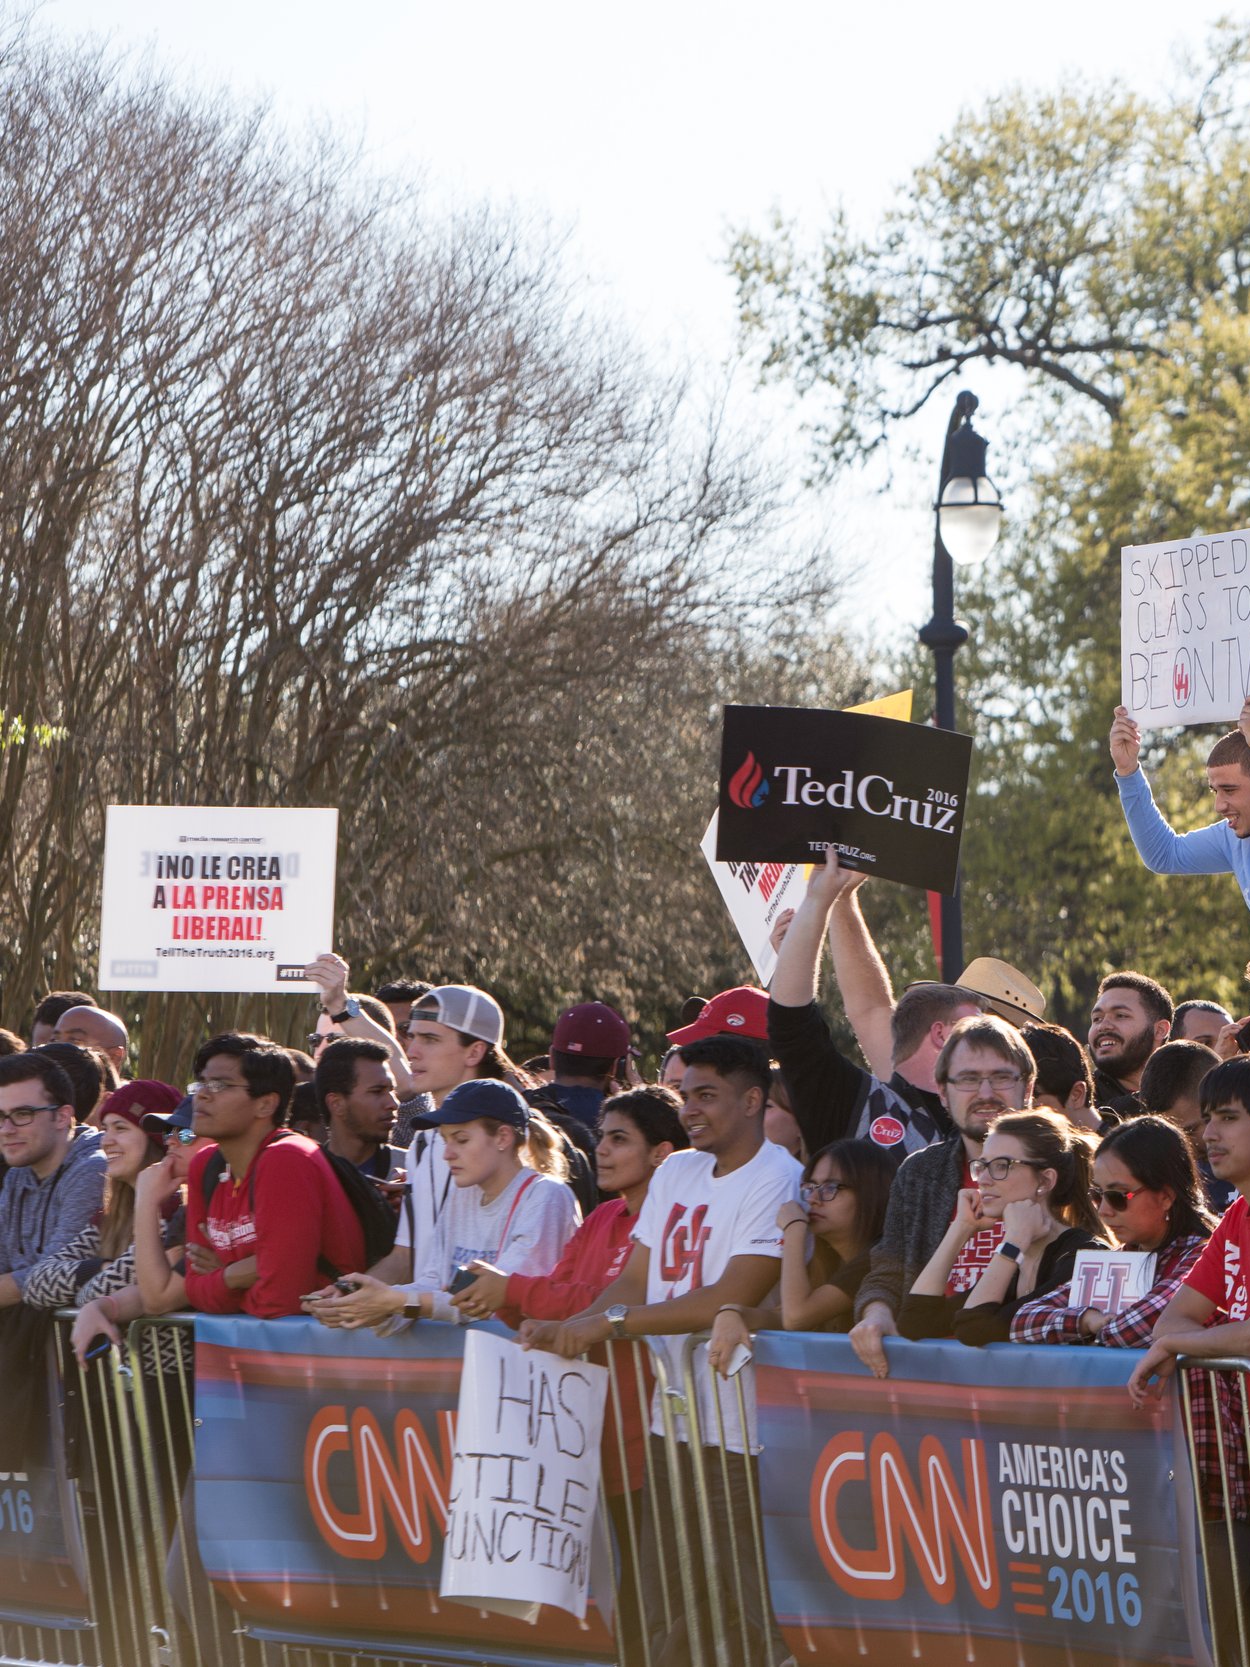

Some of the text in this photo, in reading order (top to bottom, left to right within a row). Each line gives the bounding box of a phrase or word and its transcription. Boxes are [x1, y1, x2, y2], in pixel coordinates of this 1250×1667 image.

[1129, 538, 1248, 596] SKIPPED
[1137, 592, 1207, 643] CLASS
[1129, 651, 1169, 711] BE
[1172, 640, 1215, 708] ON
[926, 787, 959, 808] 2016
[201, 855, 221, 880] LE
[227, 856, 281, 880] CREA
[152, 885, 284, 911] A LA PRENSA
[171, 915, 264, 941] LIBERAL!
[155, 947, 275, 961] TellTheTruth2016.org
[280, 968, 309, 978] #TTT
[872, 1124, 901, 1138] Cruz
[496, 1356, 591, 1459] HAS
[998, 1442, 1129, 1494] AMERICA'S
[0, 1488, 34, 1534] 16
[810, 1431, 999, 1610] CNN
[1000, 1489, 1137, 1564] CHOICE
[446, 1507, 589, 1593] UNCTION
[1047, 1566, 1143, 1628] 2016
